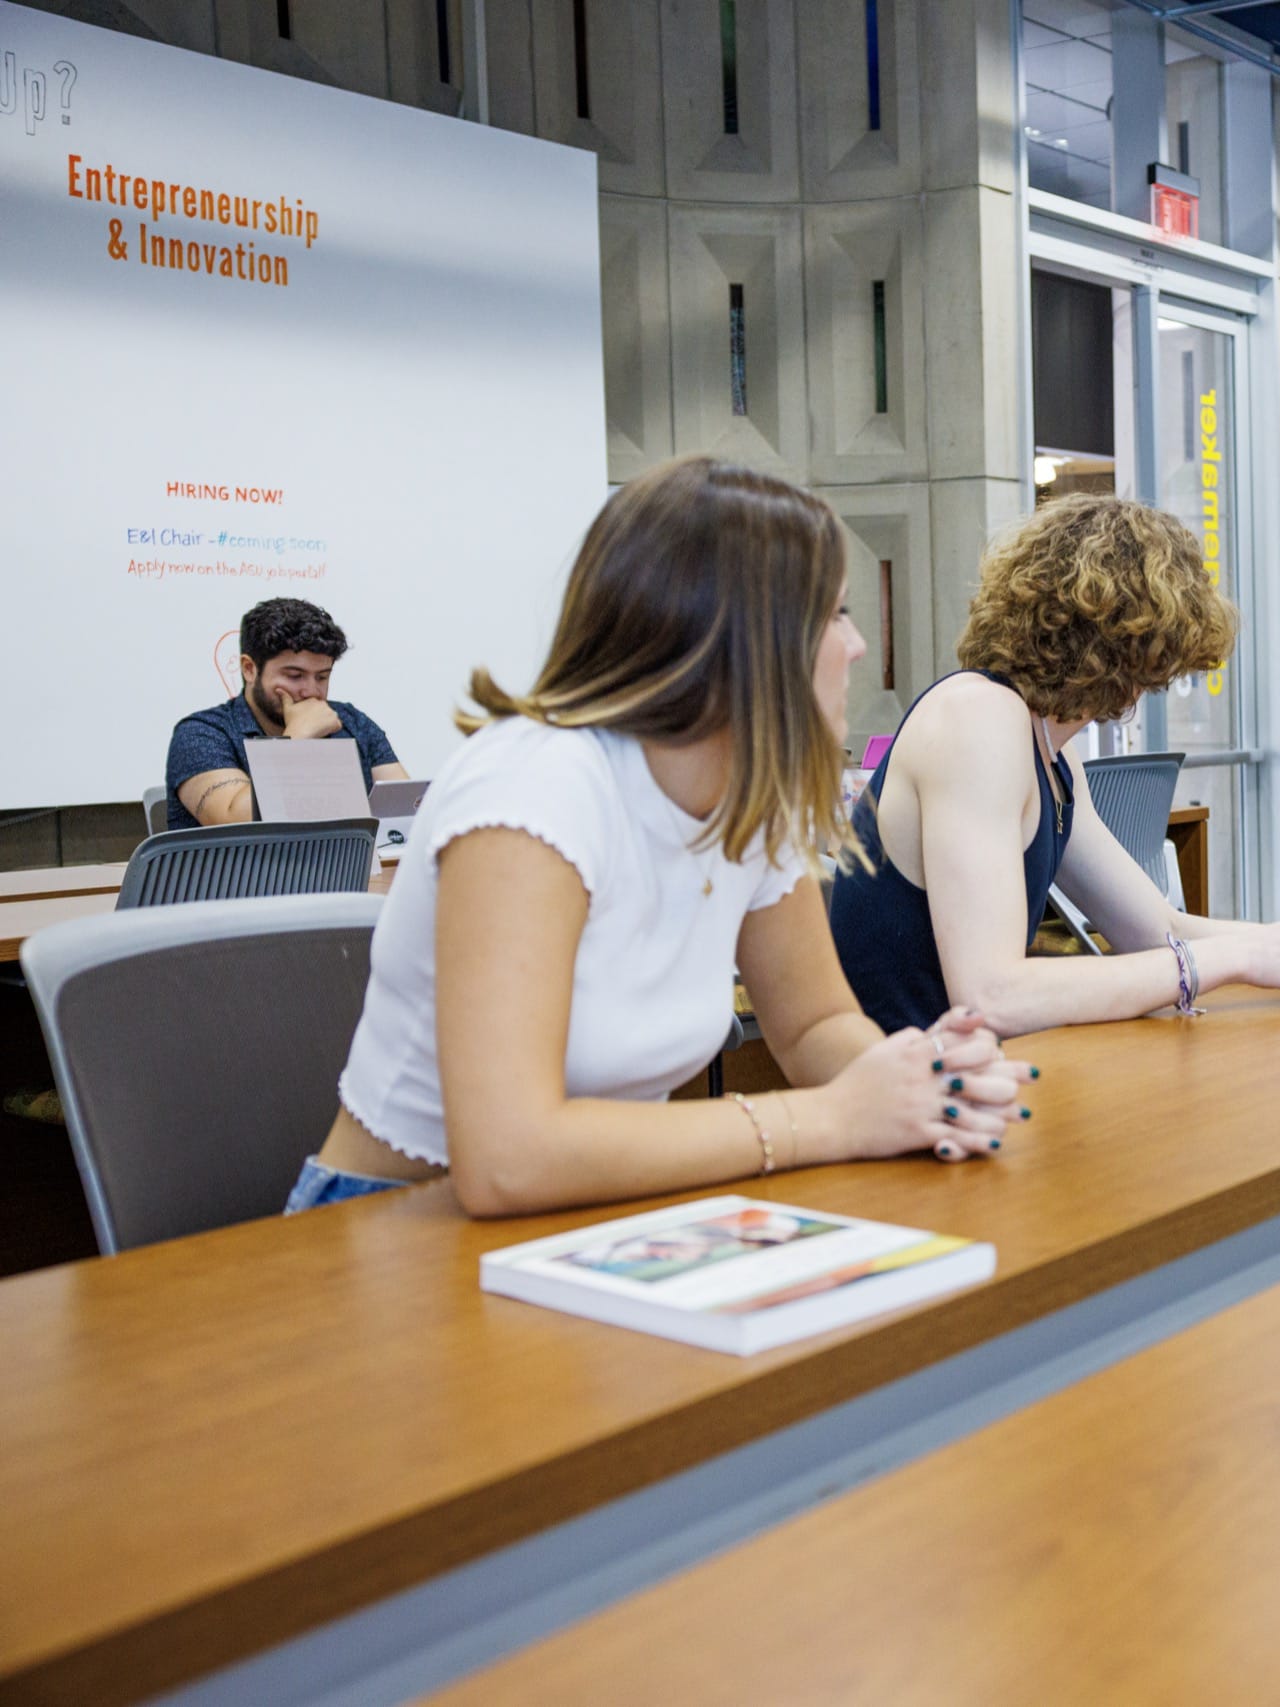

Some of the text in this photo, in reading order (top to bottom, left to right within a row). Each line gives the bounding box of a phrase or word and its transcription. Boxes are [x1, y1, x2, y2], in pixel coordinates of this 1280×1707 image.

[68, 154, 318, 249] Entrepreneurship
[107, 218, 288, 286] & Innovation
[166, 481, 283, 505] HIRING NOW!
[160, 528, 203, 547] Chair
[127, 559, 166, 580] Apply
[168, 564, 194, 575] now
[197, 565, 213, 576] on
[216, 561, 237, 577] the
